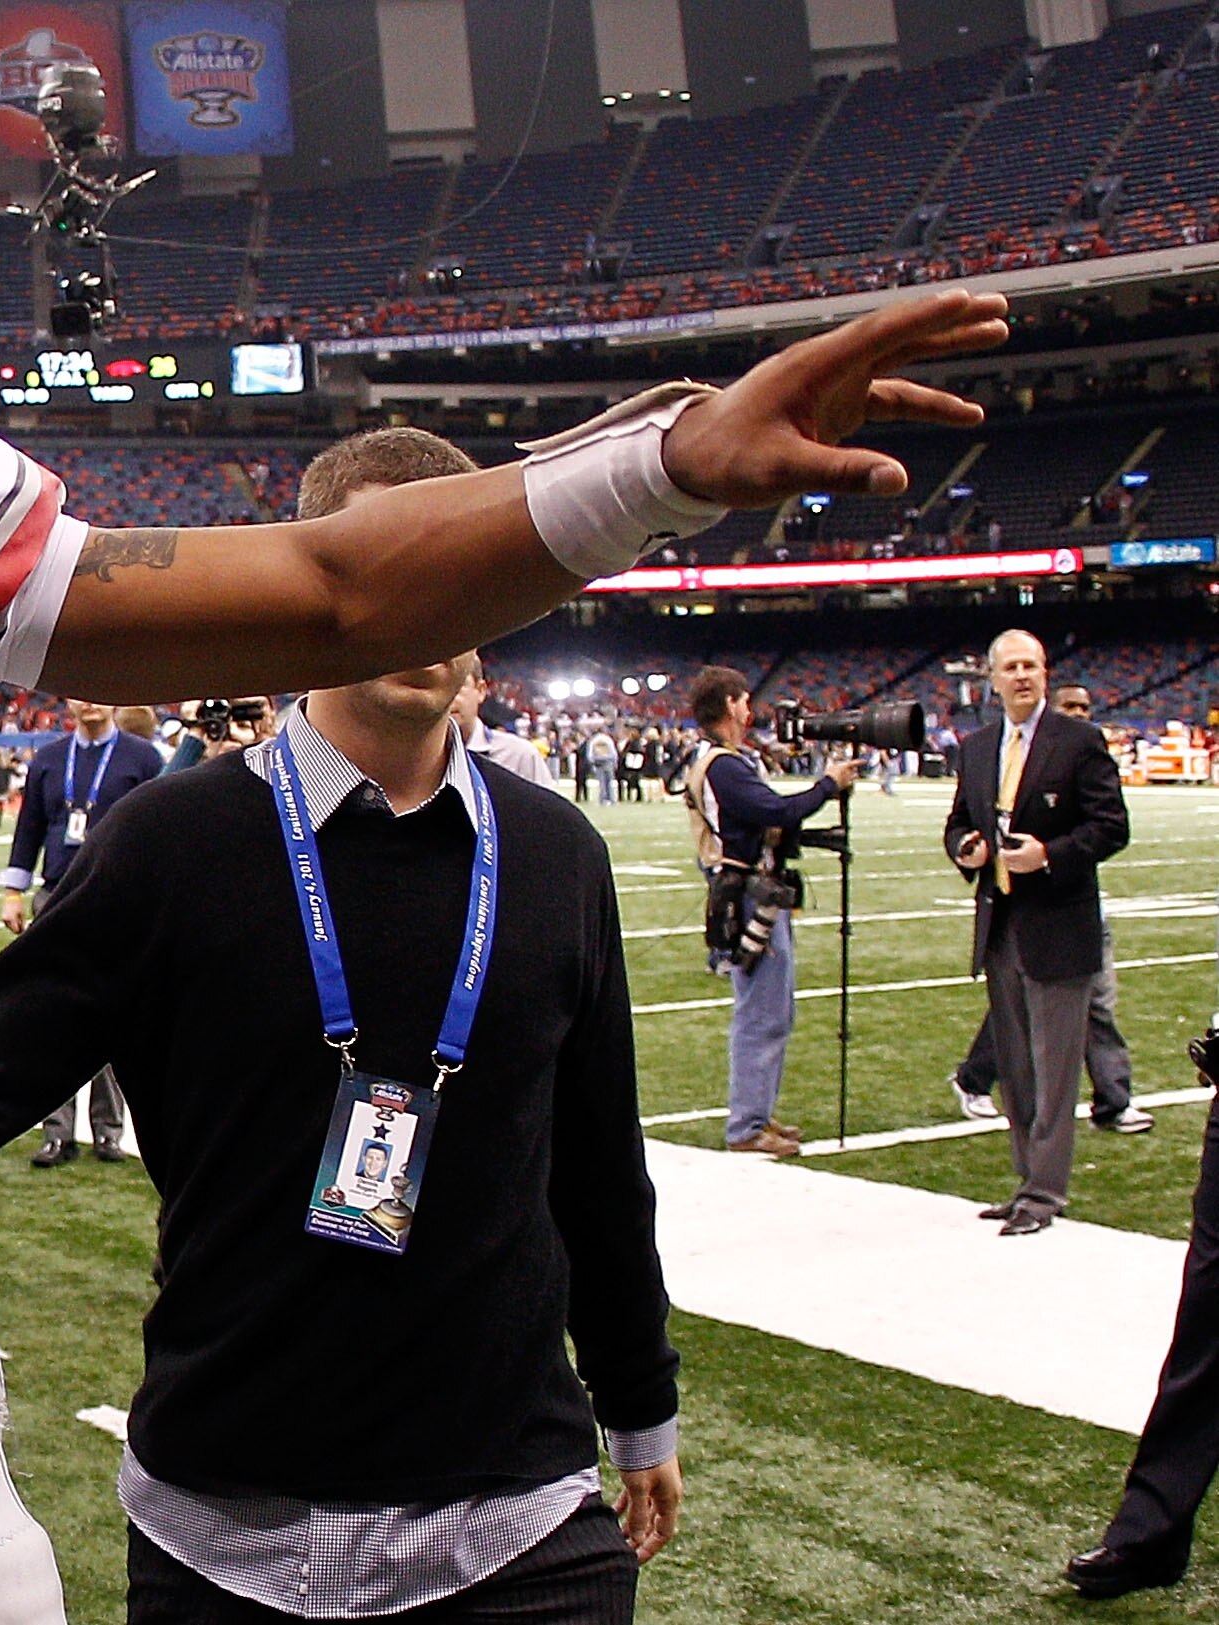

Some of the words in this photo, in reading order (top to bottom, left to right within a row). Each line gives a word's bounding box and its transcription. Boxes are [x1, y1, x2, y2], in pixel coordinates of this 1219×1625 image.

[173, 51, 245, 71] Allstate
[284, 792, 305, 841] Louisiana
[297, 854, 314, 880] 2011
[309, 895, 328, 942] January
[476, 876, 491, 929] Louisiana
[464, 928, 487, 990] Superdome
